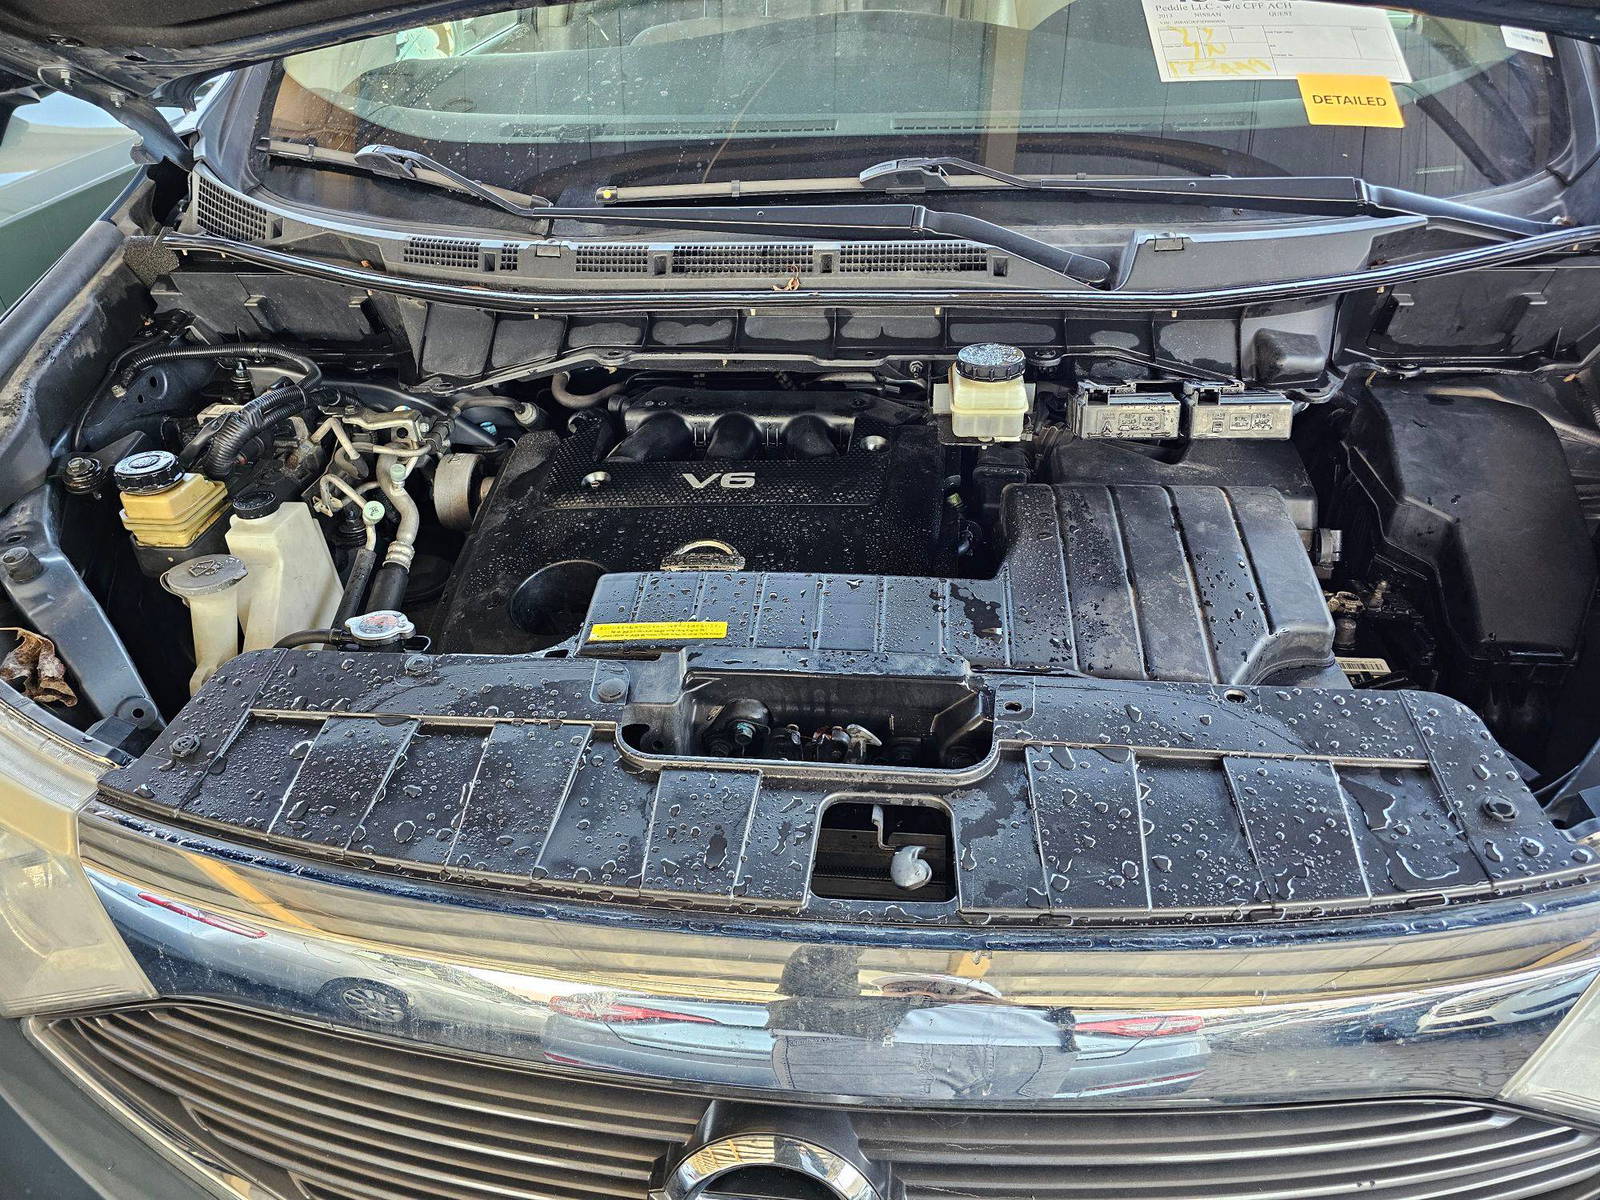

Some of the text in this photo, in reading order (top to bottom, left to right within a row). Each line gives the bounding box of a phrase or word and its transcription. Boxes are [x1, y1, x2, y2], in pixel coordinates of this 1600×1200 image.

[1155, 4, 1189, 12] Peddle
[1312, 94, 1387, 107] DETAILED
[681, 471, 756, 489] V6
